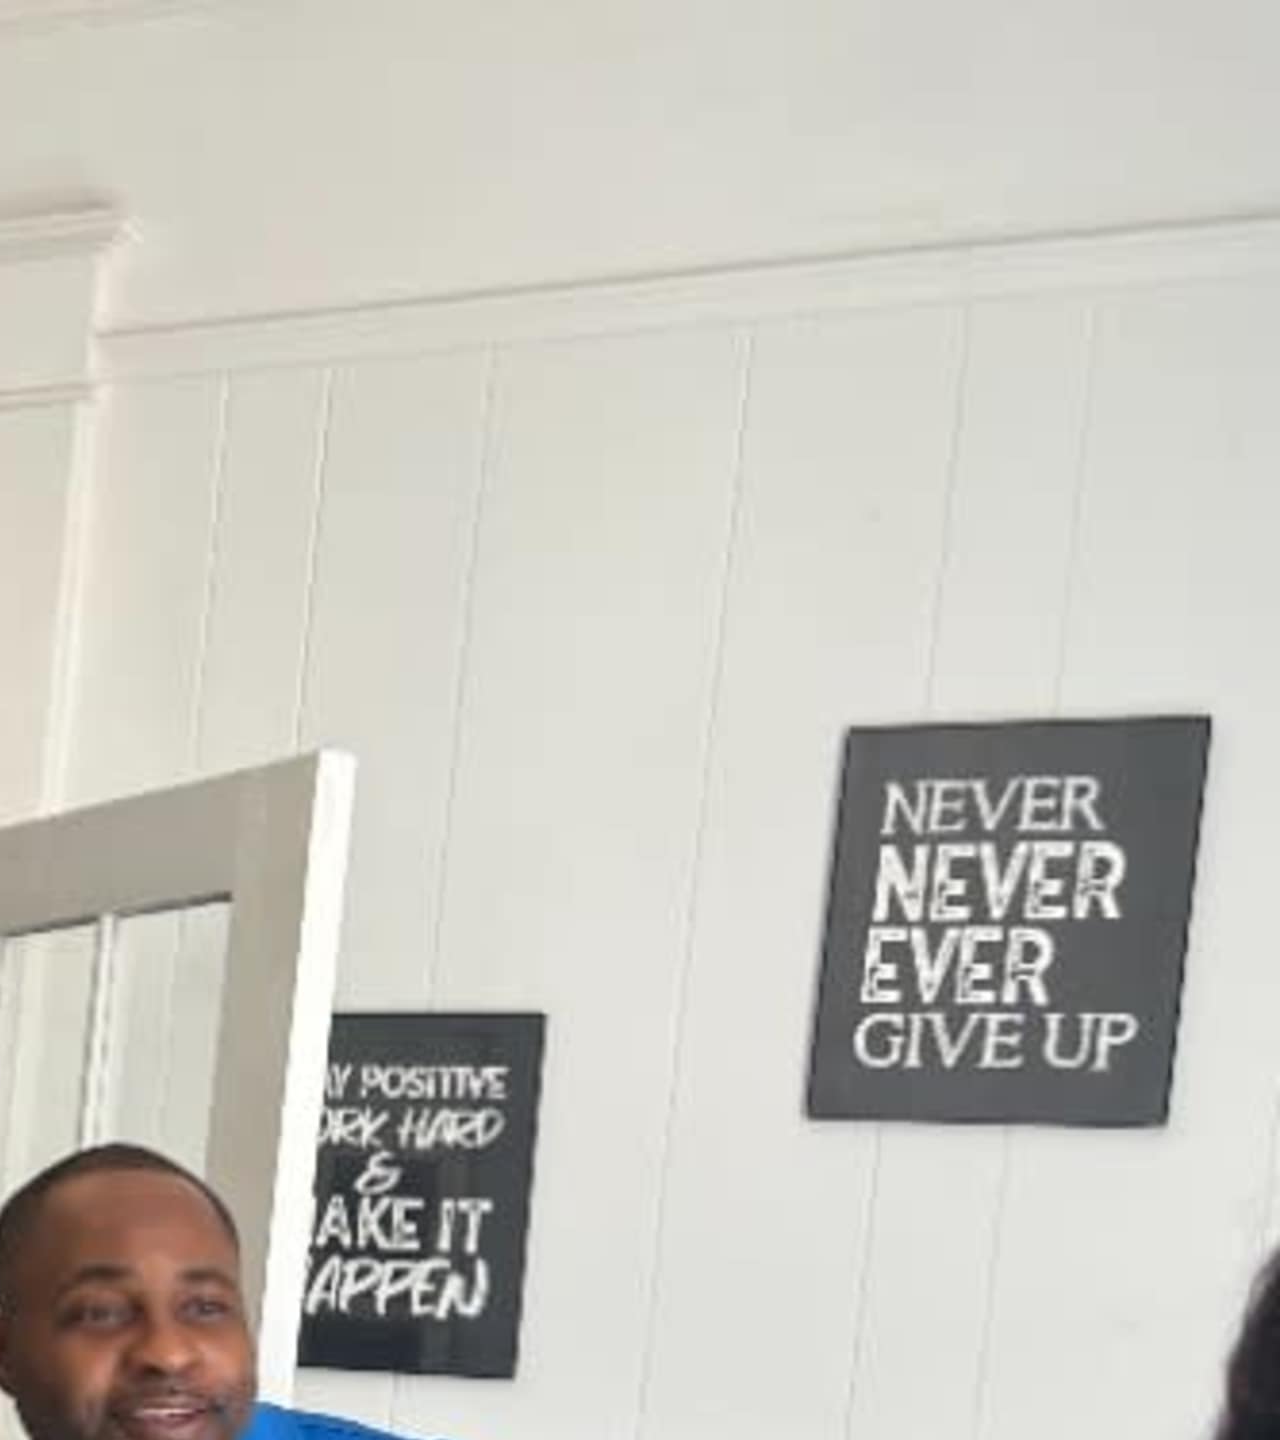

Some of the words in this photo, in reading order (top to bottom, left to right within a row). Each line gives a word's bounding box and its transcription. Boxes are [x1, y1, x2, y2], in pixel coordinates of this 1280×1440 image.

[880, 775, 1107, 836] NEVER
[872, 840, 1127, 923] NEVER
[860, 925, 1055, 1005] EVER
[853, 1012, 1027, 1070] GIVE
[1041, 1012, 1139, 1073] UP
[360, 1065, 510, 1100] POSITIVE
[316, 1104, 391, 1151] ORK
[397, 1105, 507, 1150] HARD
[353, 1150, 403, 1196] &
[316, 1195, 424, 1250] AKE
[437, 1197, 495, 1254] IT
[304, 1254, 489, 1321] APPEN
